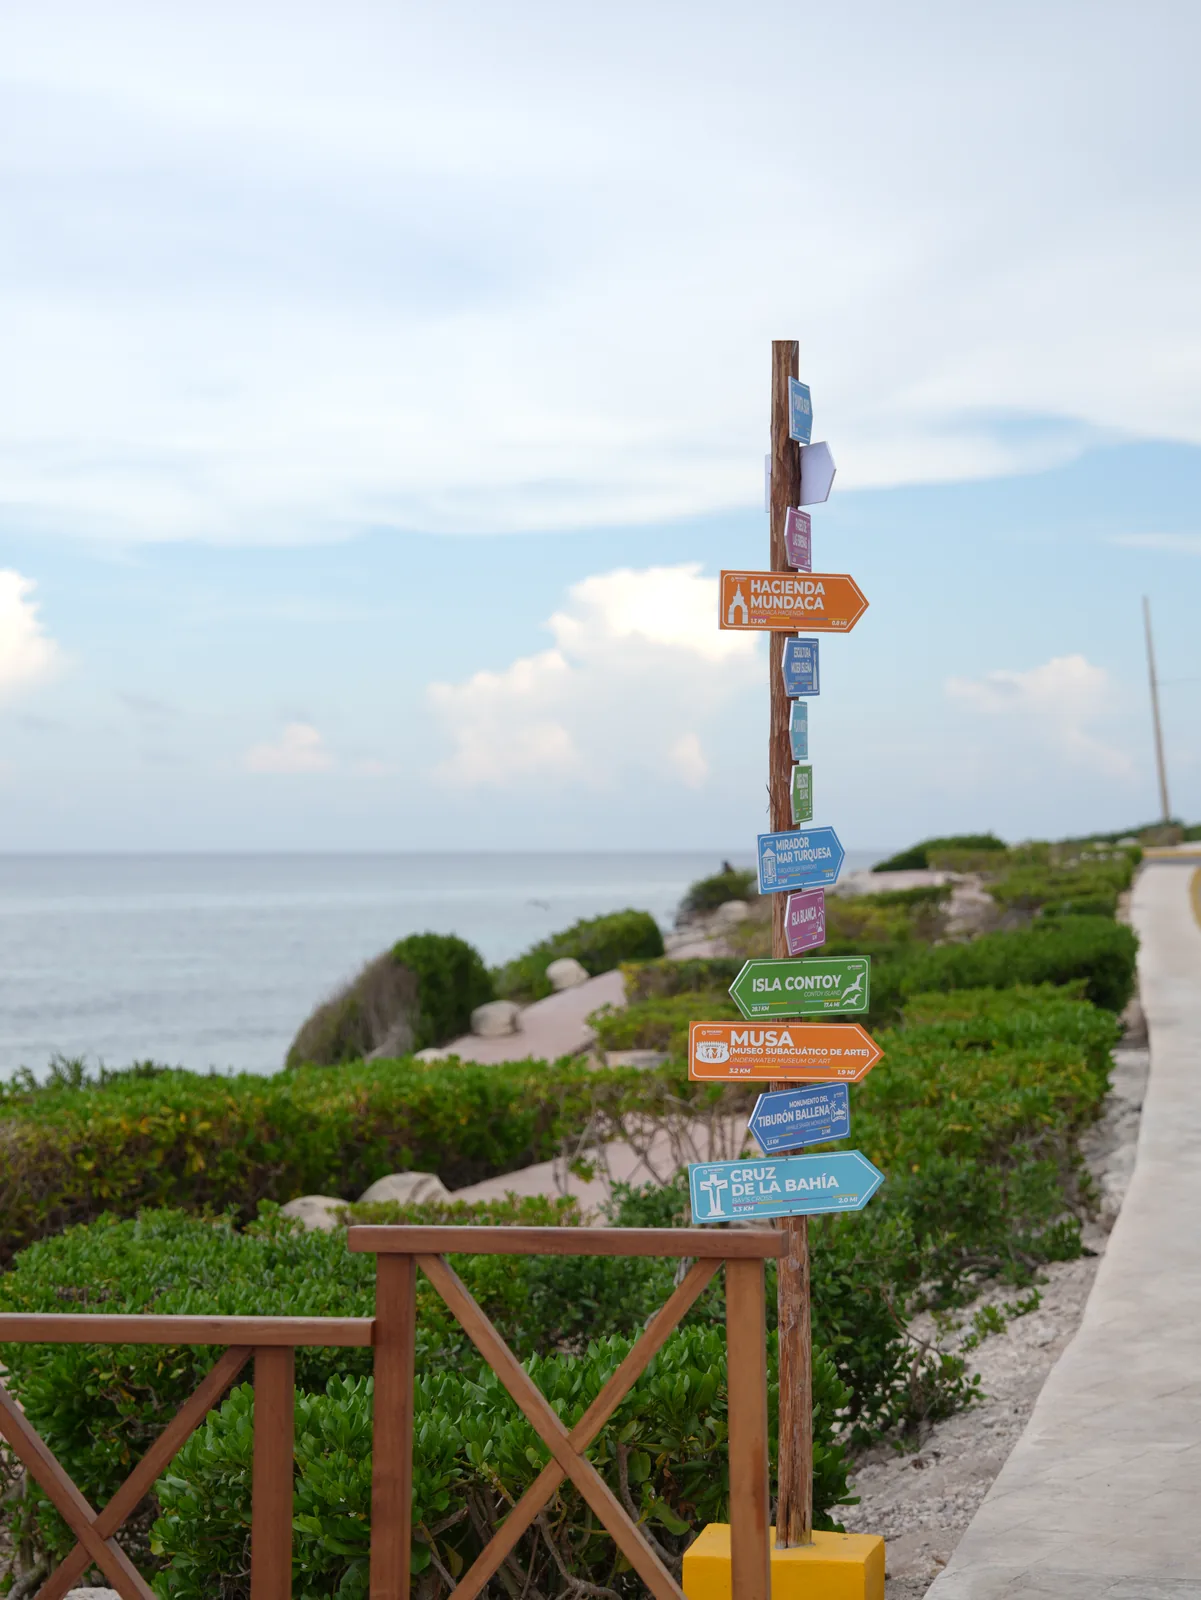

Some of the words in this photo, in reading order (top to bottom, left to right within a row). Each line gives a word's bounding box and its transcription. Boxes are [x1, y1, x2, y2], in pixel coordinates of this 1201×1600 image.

[750, 580, 826, 595] HACIENDA
[750, 595, 824, 610] MUNDACA
[776, 837, 809, 851] MIRADOR
[776, 851, 793, 864] MAR
[794, 847, 832, 862] TURQUESA
[800, 906, 817, 924] BLANCA
[752, 978, 782, 992] ISLA
[785, 975, 842, 990] CONTOY
[730, 1030, 793, 1047] MUSA
[730, 1047, 763, 1056] (MUSEO
[765, 1047, 828, 1056] SUBACUÁTICO
[844, 1048, 870, 1057] ARTE)
[789, 1097, 820, 1108] MONUMENTO
[758, 1110, 794, 1127] TIBURÓN
[796, 1105, 830, 1120] BALLENA
[730, 1167, 776, 1182] CRUZ
[732, 1183, 755, 1196] DE
[760, 1181, 781, 1195] LA
[786, 1173, 839, 1193] BAHÍA
